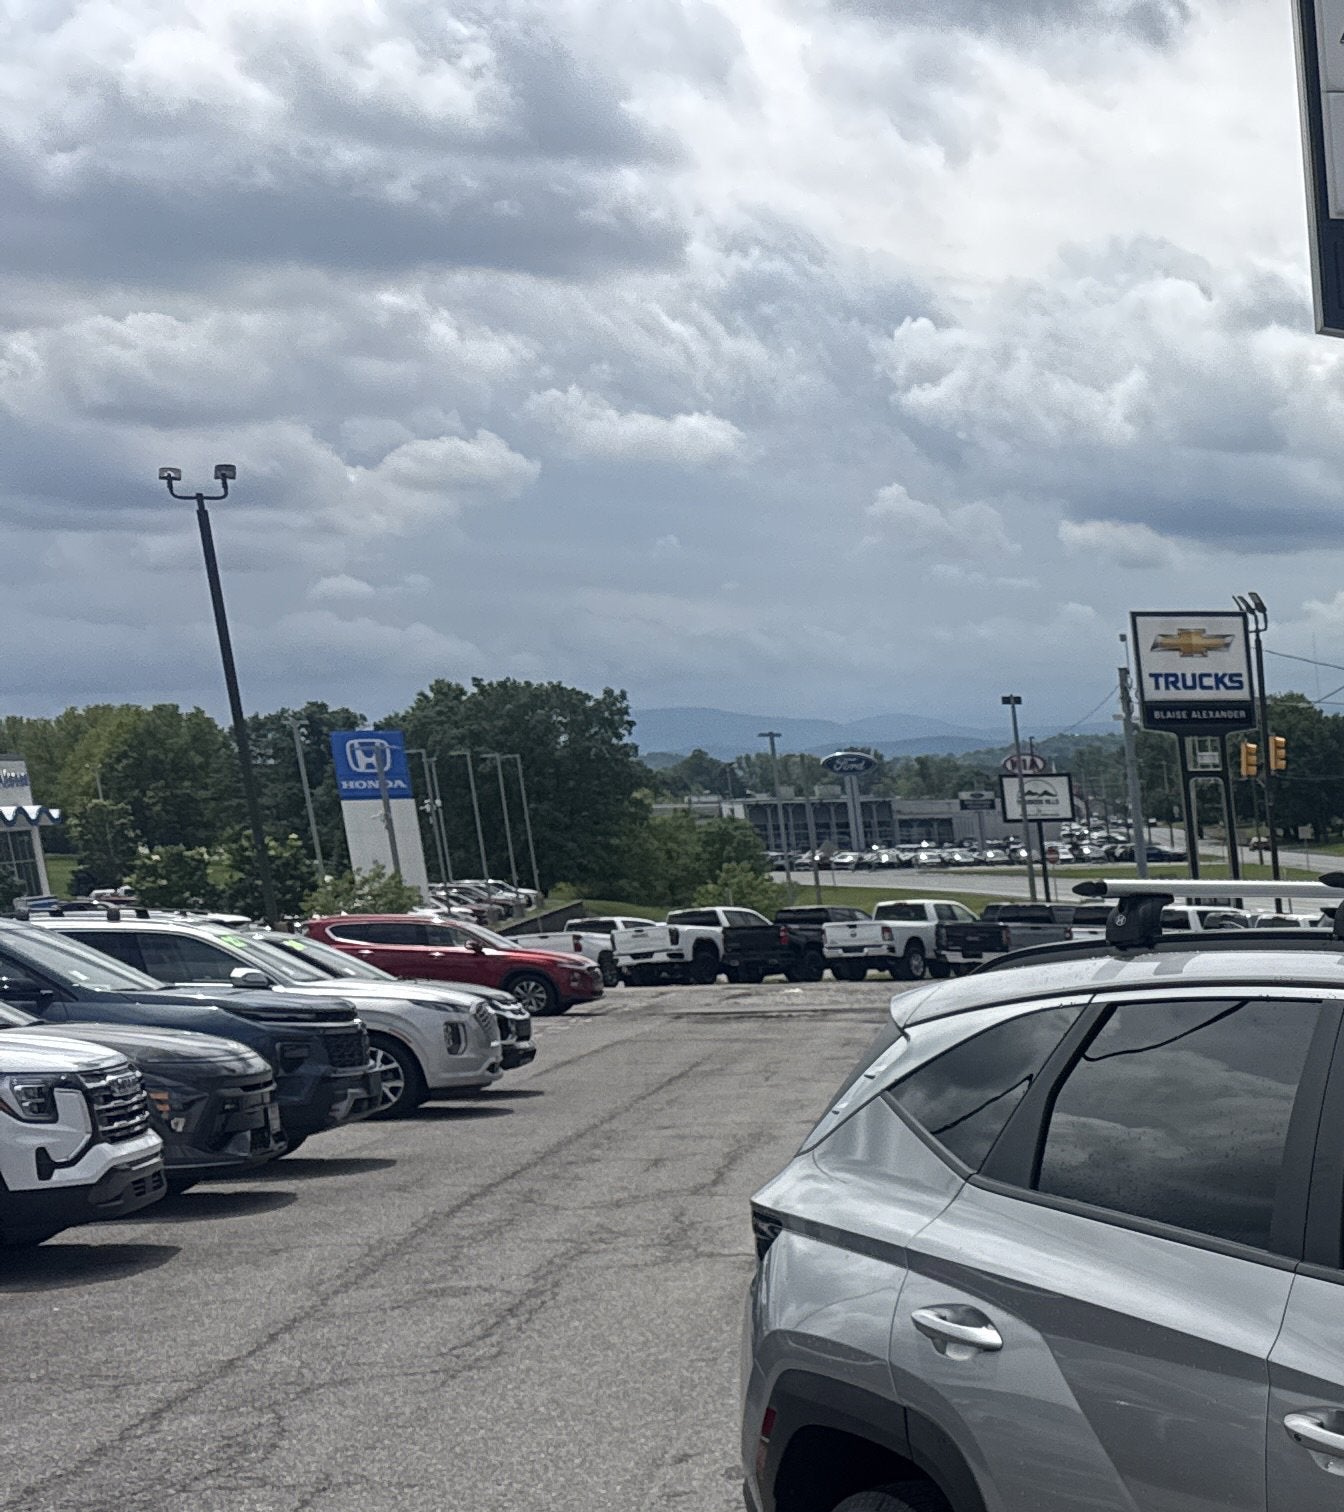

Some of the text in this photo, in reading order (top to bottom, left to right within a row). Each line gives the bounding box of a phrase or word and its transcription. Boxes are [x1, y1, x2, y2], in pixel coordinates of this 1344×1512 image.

[1148, 673, 1244, 690] TRUCKS
[1153, 709, 1246, 719] BLAISE ALEXANDER
[833, 757, 866, 771] Ford
